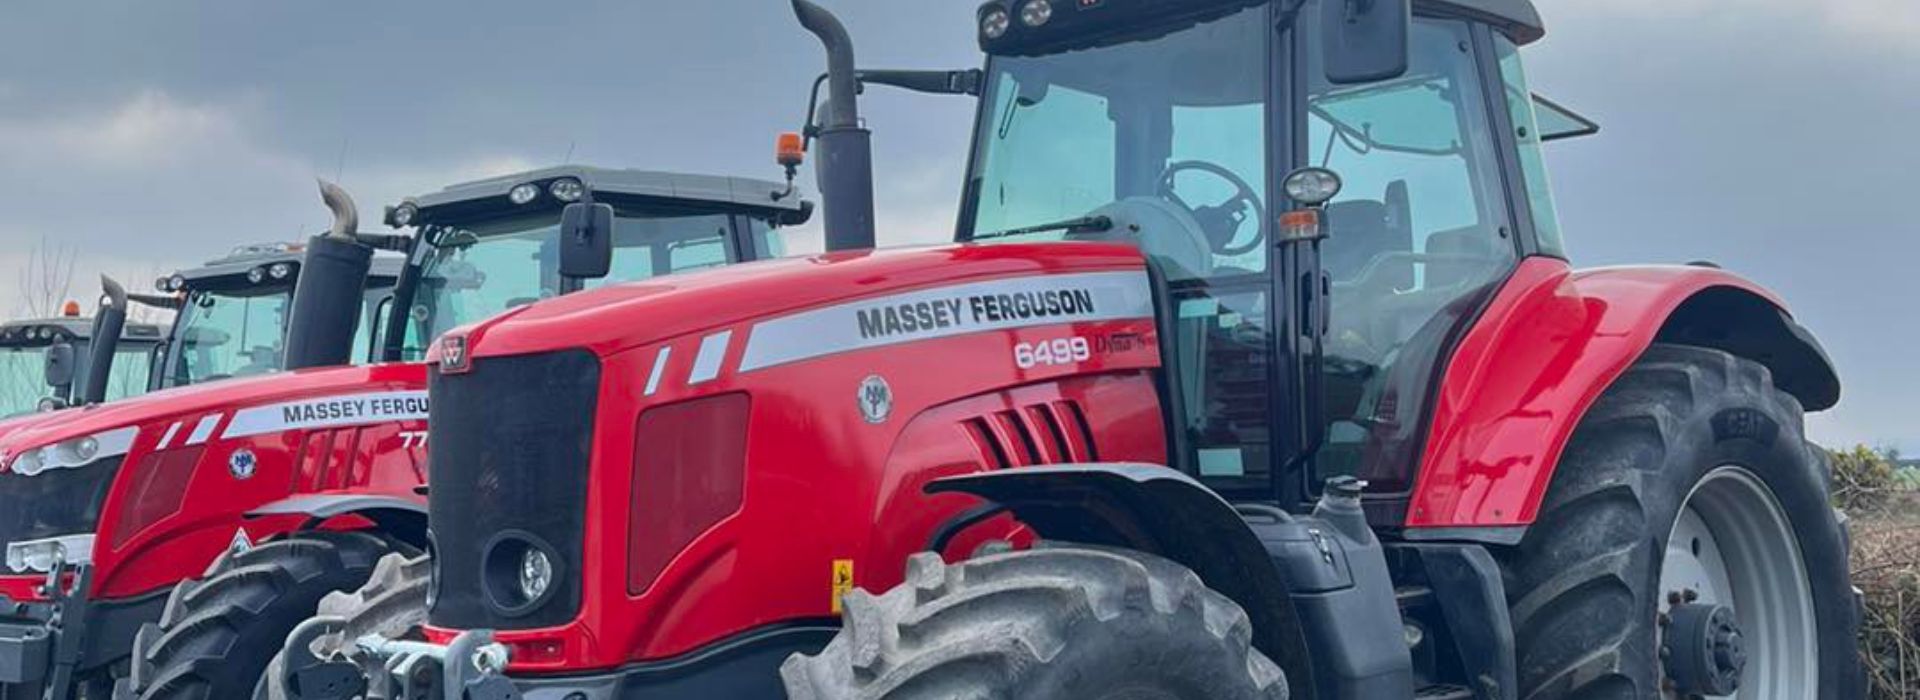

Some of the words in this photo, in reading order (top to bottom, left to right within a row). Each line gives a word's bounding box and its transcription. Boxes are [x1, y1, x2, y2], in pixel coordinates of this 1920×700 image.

[857, 298, 962, 339] MASSEY
[970, 289, 1094, 324] FERGUSON
[1014, 336, 1090, 369] 6499
[283, 399, 364, 423] MASSEY
[371, 398, 429, 415] FERGU
[398, 432, 429, 448] 77
